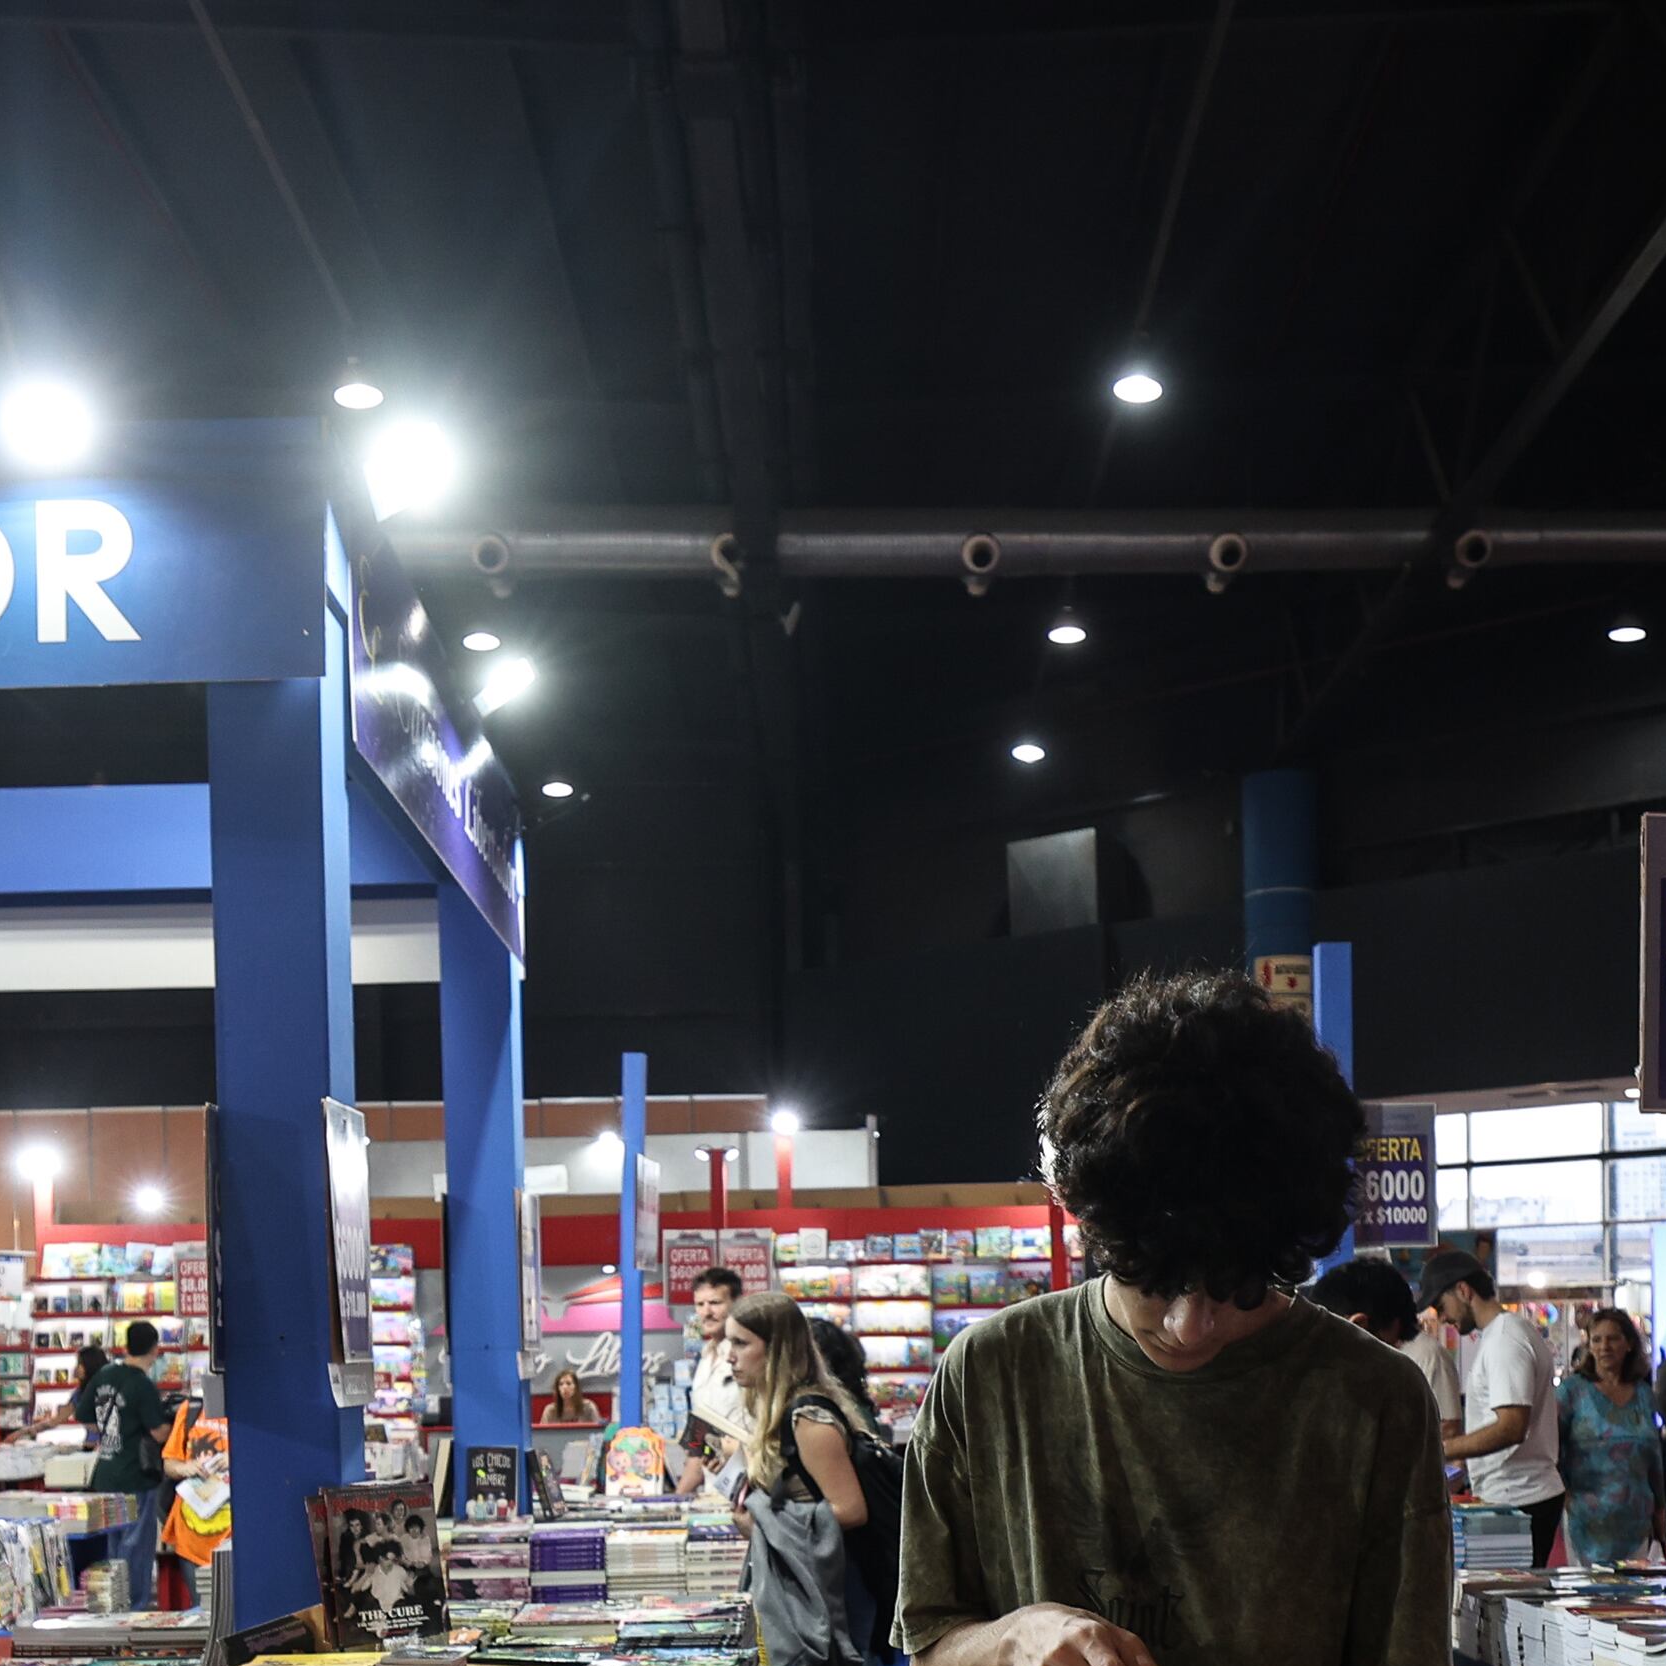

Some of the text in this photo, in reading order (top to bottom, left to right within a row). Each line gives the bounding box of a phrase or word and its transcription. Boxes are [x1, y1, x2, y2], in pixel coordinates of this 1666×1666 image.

[1376, 1206, 1427, 1224] $10000
[670, 1249, 710, 1263] OFERTA
[179, 1261, 207, 1275] OFER
[387, 1604, 424, 1619] CURE
